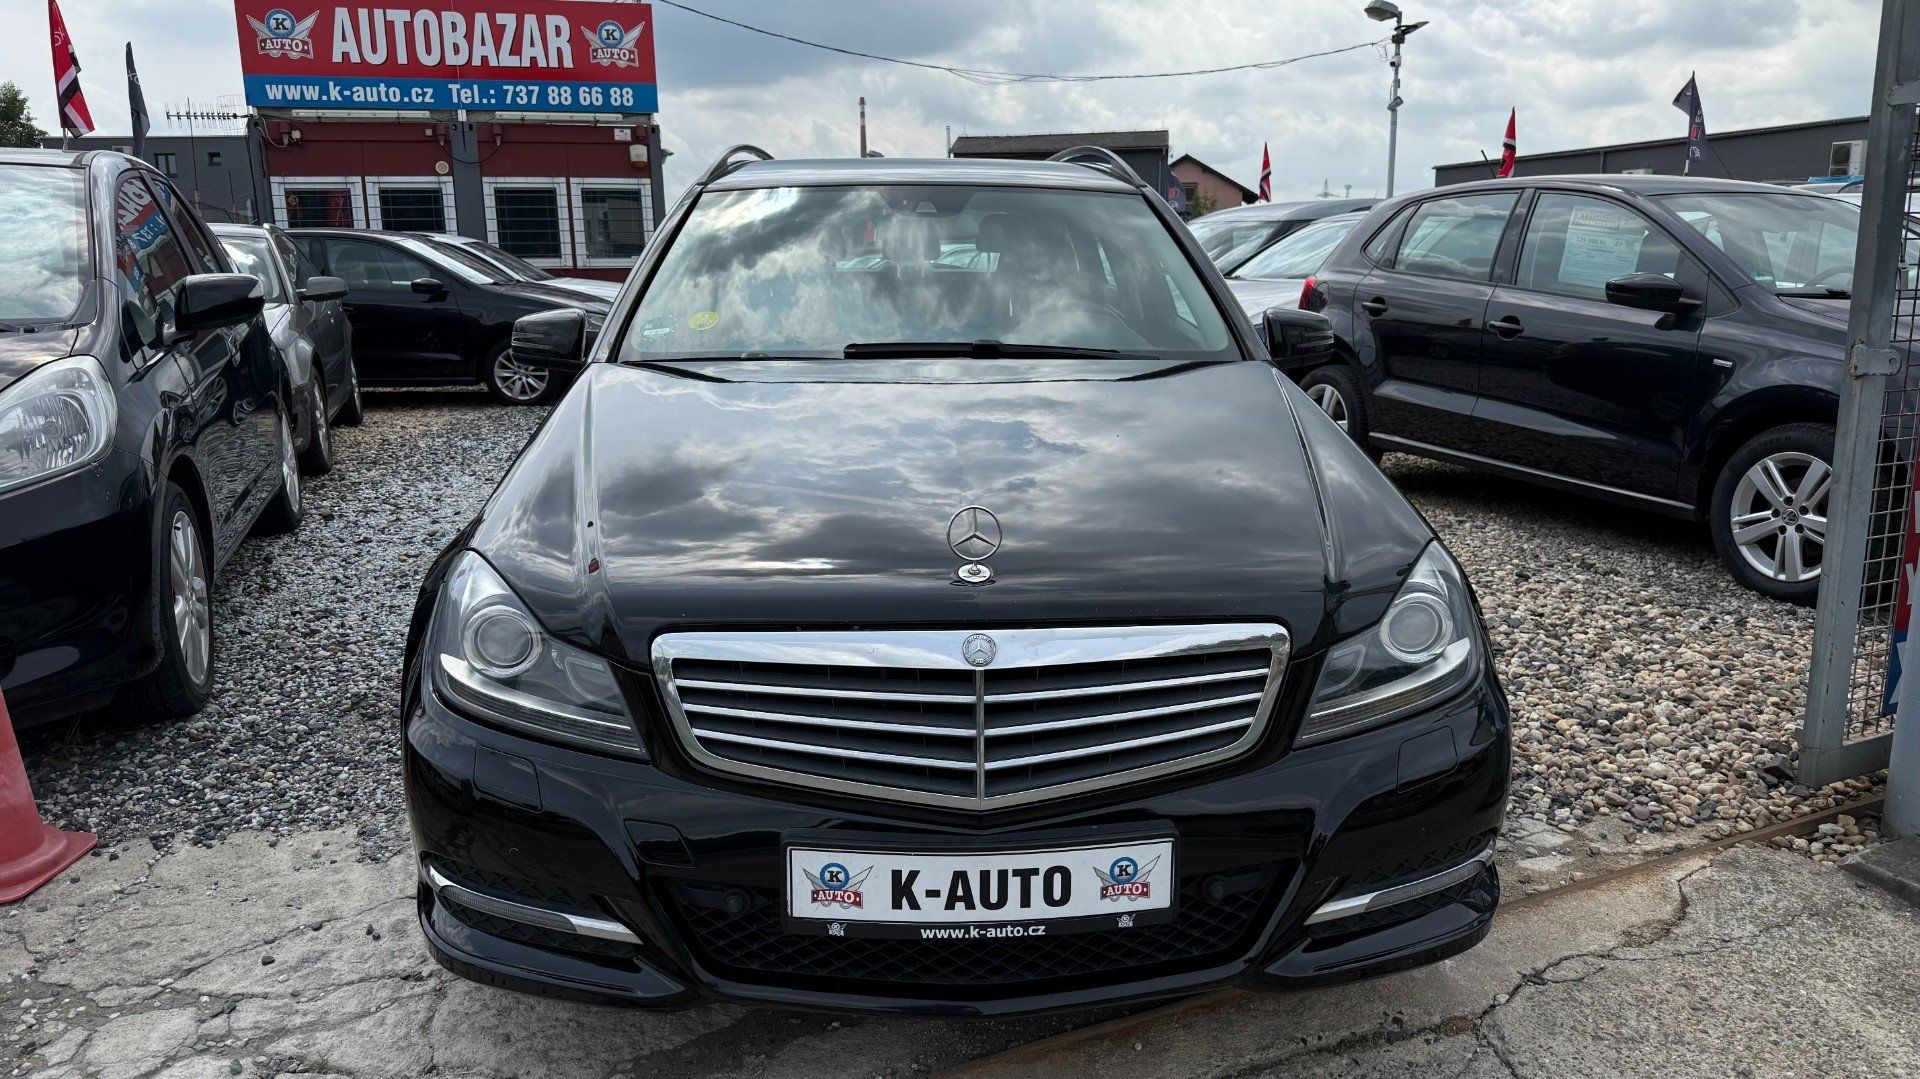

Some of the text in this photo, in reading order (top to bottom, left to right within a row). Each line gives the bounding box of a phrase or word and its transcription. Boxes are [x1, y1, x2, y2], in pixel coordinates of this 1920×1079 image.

[272, 17, 289, 31] K
[332, 7, 574, 69] AUTOBAZAR
[604, 28, 618, 41] K
[265, 38, 303, 52] AUTO
[596, 48, 630, 61] AUTO
[265, 81, 634, 107] www.k-auto.cz Tel.: 737 88 66 88
[827, 870, 843, 883] K
[1116, 864, 1132, 877] K
[891, 865, 1072, 911] K-AUTO
[1106, 883, 1142, 896] AUTO
[817, 890, 855, 904] AUTO
[920, 925, 1046, 938] www.k-auto.cz
